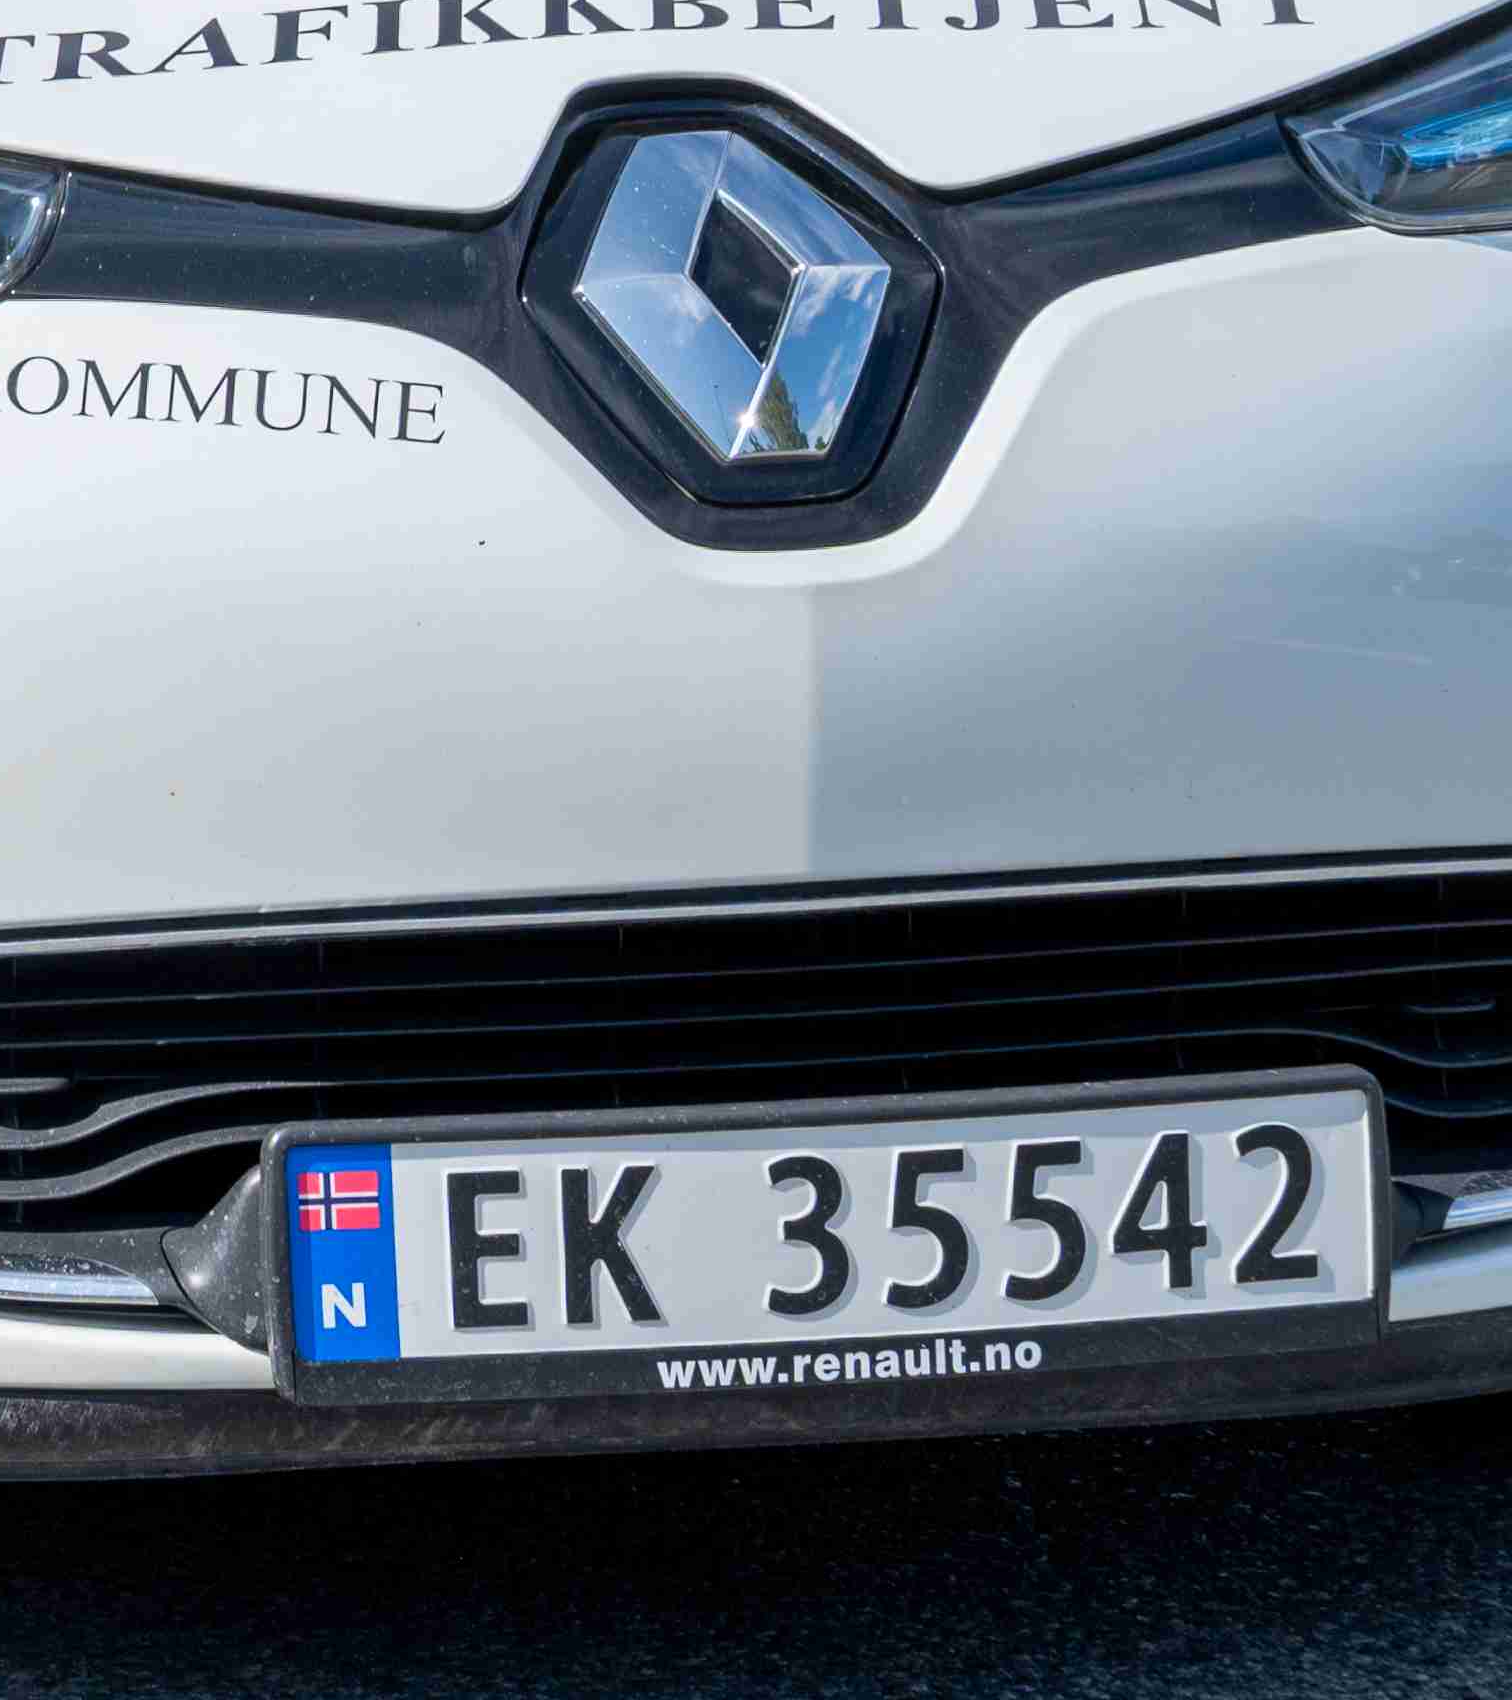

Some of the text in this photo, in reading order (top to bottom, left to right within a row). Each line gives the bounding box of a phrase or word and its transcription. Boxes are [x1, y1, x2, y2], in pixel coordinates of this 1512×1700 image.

[448, 1124, 1321, 1328] EK 35542
[321, 1282, 368, 1329] N
[656, 1338, 1043, 1389] www.renault.no
